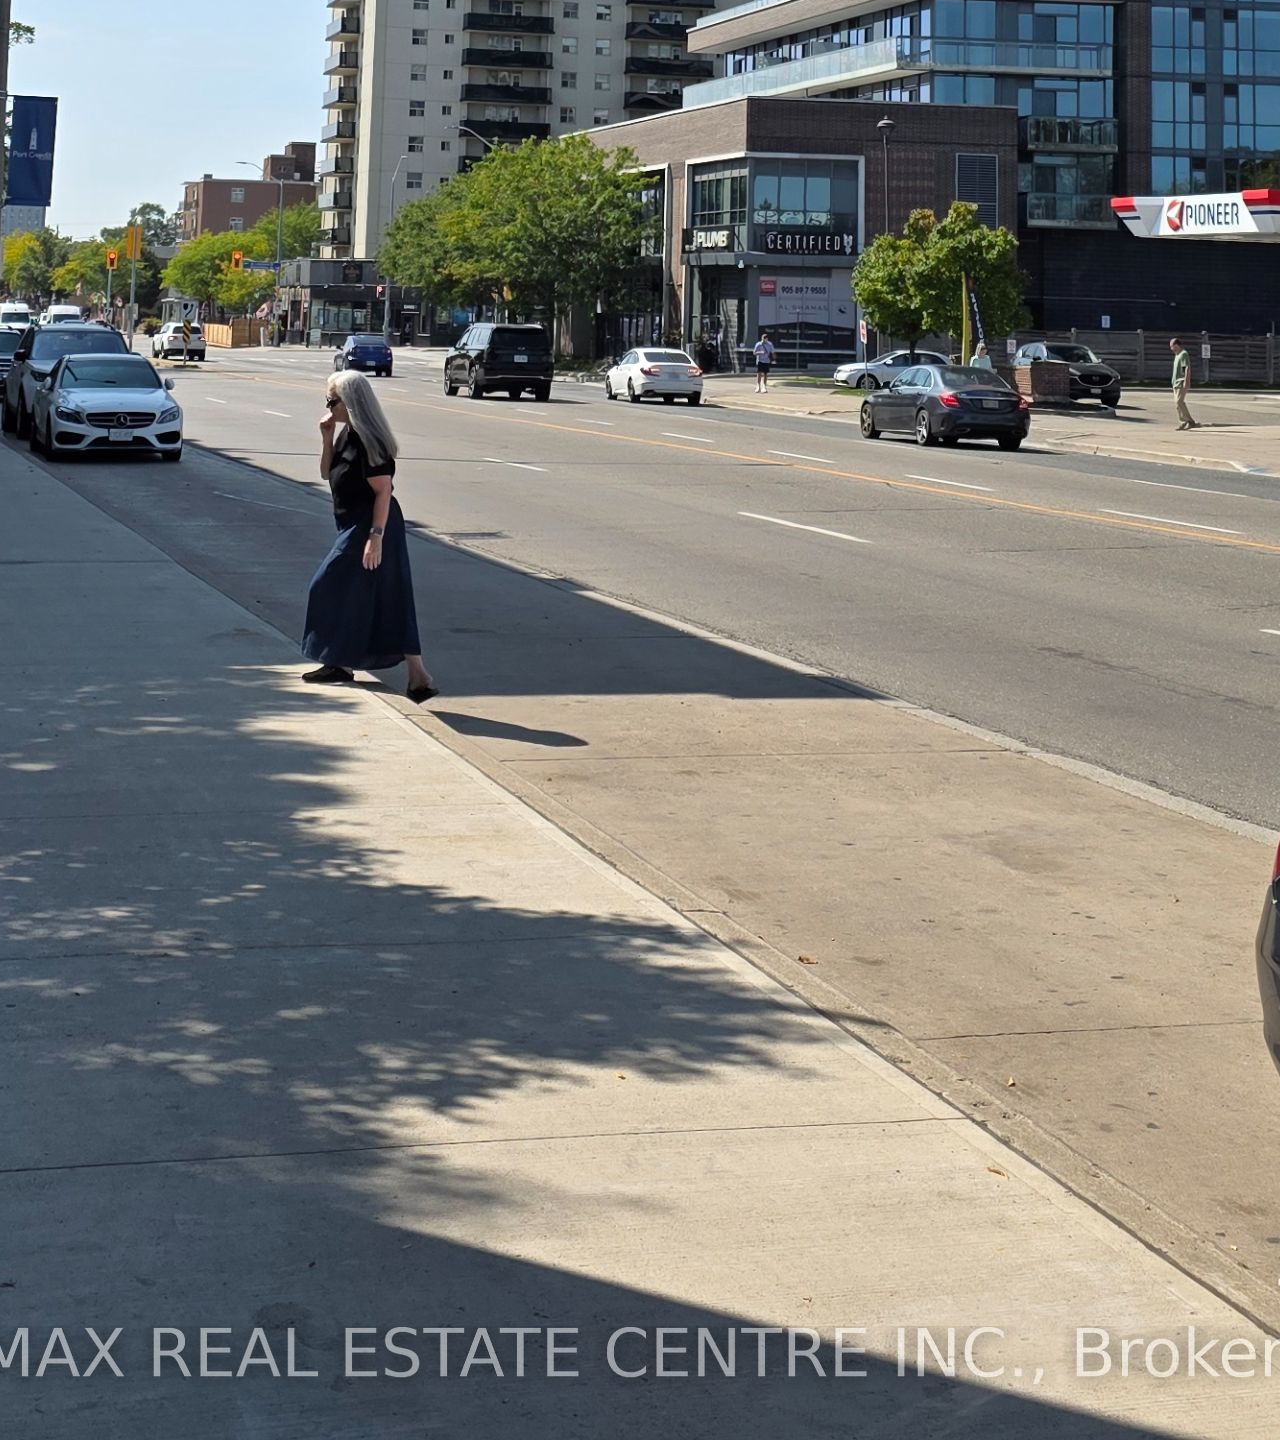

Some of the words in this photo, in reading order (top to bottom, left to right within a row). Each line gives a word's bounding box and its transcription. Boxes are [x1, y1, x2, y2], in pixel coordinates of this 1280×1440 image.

[1185, 202, 1240, 227] PIONEER
[697, 230, 730, 248] PLUMB
[766, 231, 841, 251] CERTIFIED
